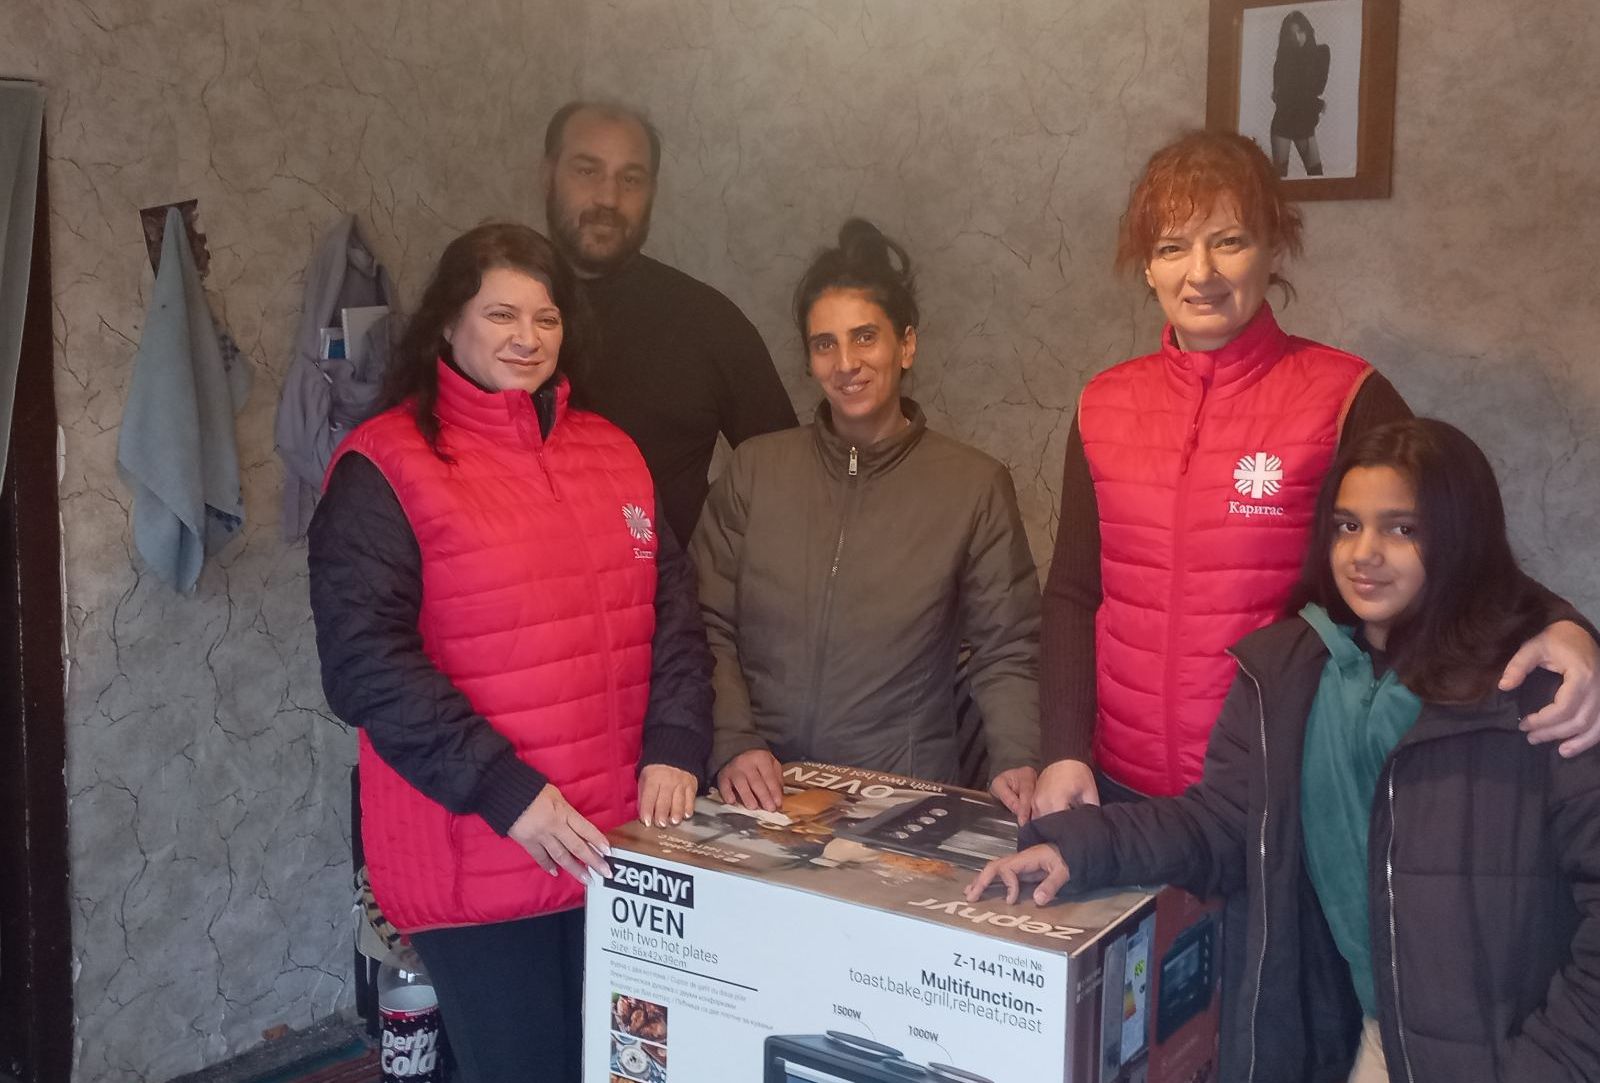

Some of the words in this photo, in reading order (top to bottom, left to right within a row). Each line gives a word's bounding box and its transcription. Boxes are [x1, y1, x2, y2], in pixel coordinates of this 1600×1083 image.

[1228, 500, 1284, 518] Каритас
[782, 766, 895, 799] OVEN
[849, 769, 876, 780] hot
[878, 775, 907, 786] two
[910, 781, 944, 793] with
[613, 863, 692, 902] zephyr
[612, 896, 684, 939] OVEN
[907, 898, 1084, 940] zephyr
[610, 927, 634, 942] with
[637, 932, 658, 948] two
[661, 936, 680, 955] hot
[682, 944, 719, 964] plates
[953, 952, 1045, 989] Z-1441-M40
[998, 954, 1028, 969] model
[921, 969, 1043, 1016] Multifunction-
[832, 1003, 862, 1020] 1500W
[382, 1028, 439, 1054] Derby
[907, 1025, 939, 1042] 1000W
[381, 1048, 437, 1077] Cola
